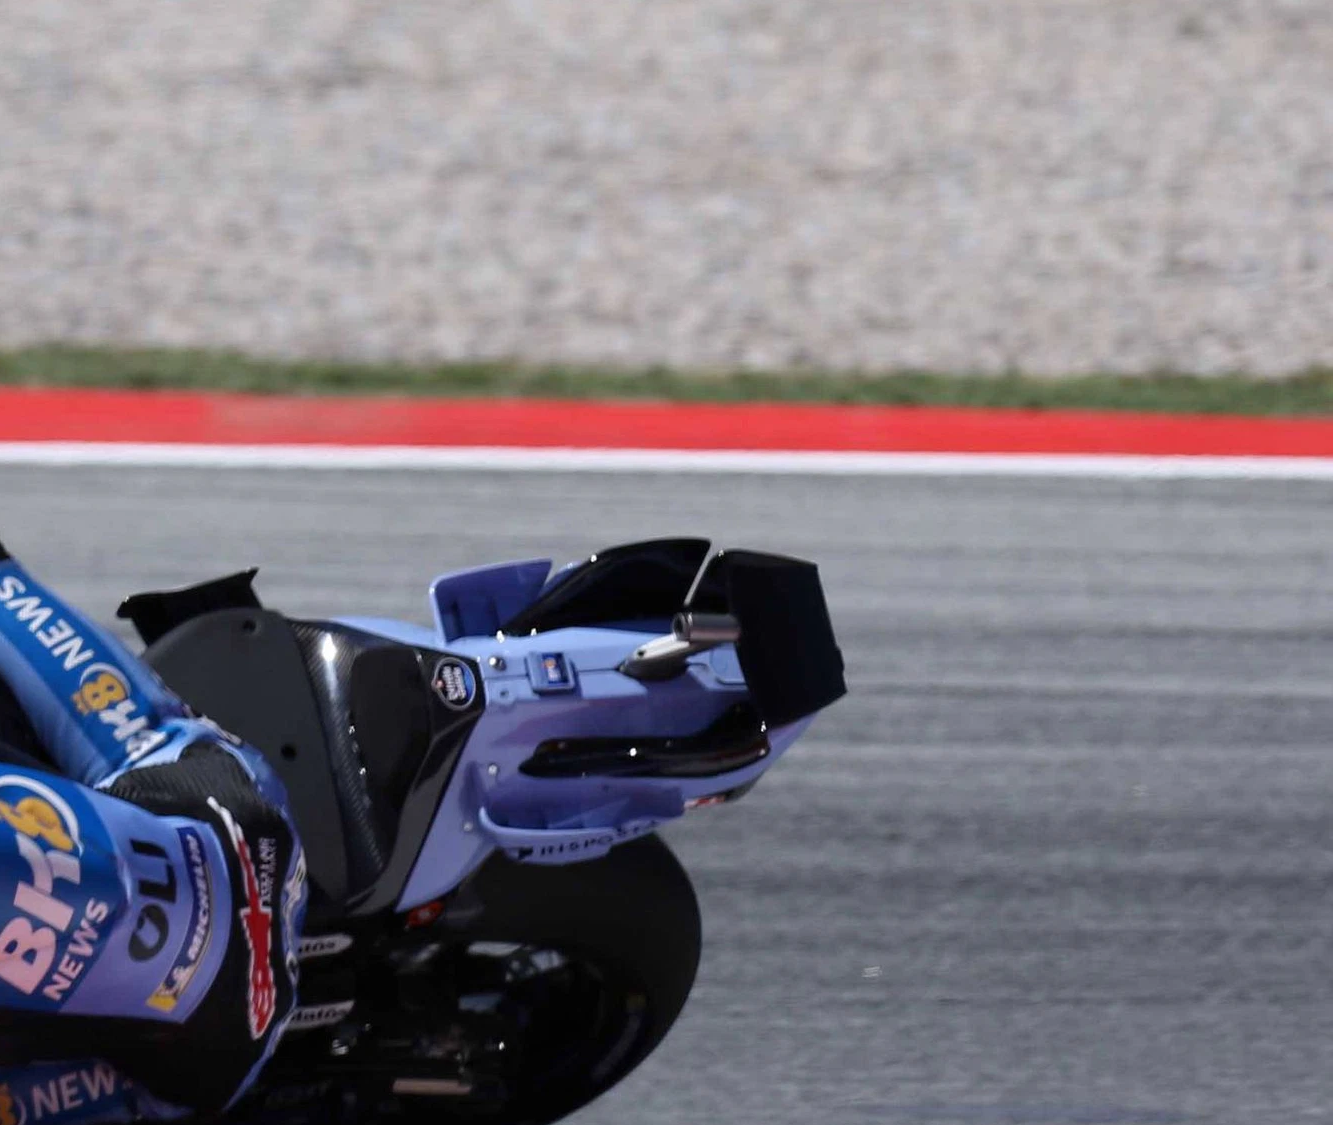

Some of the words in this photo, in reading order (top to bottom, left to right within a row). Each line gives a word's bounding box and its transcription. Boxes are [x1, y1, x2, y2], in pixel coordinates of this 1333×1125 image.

[181, 832, 212, 961] MICHELIN
[44, 897, 110, 1001] NEWS
[33, 1062, 131, 1120] NEW
